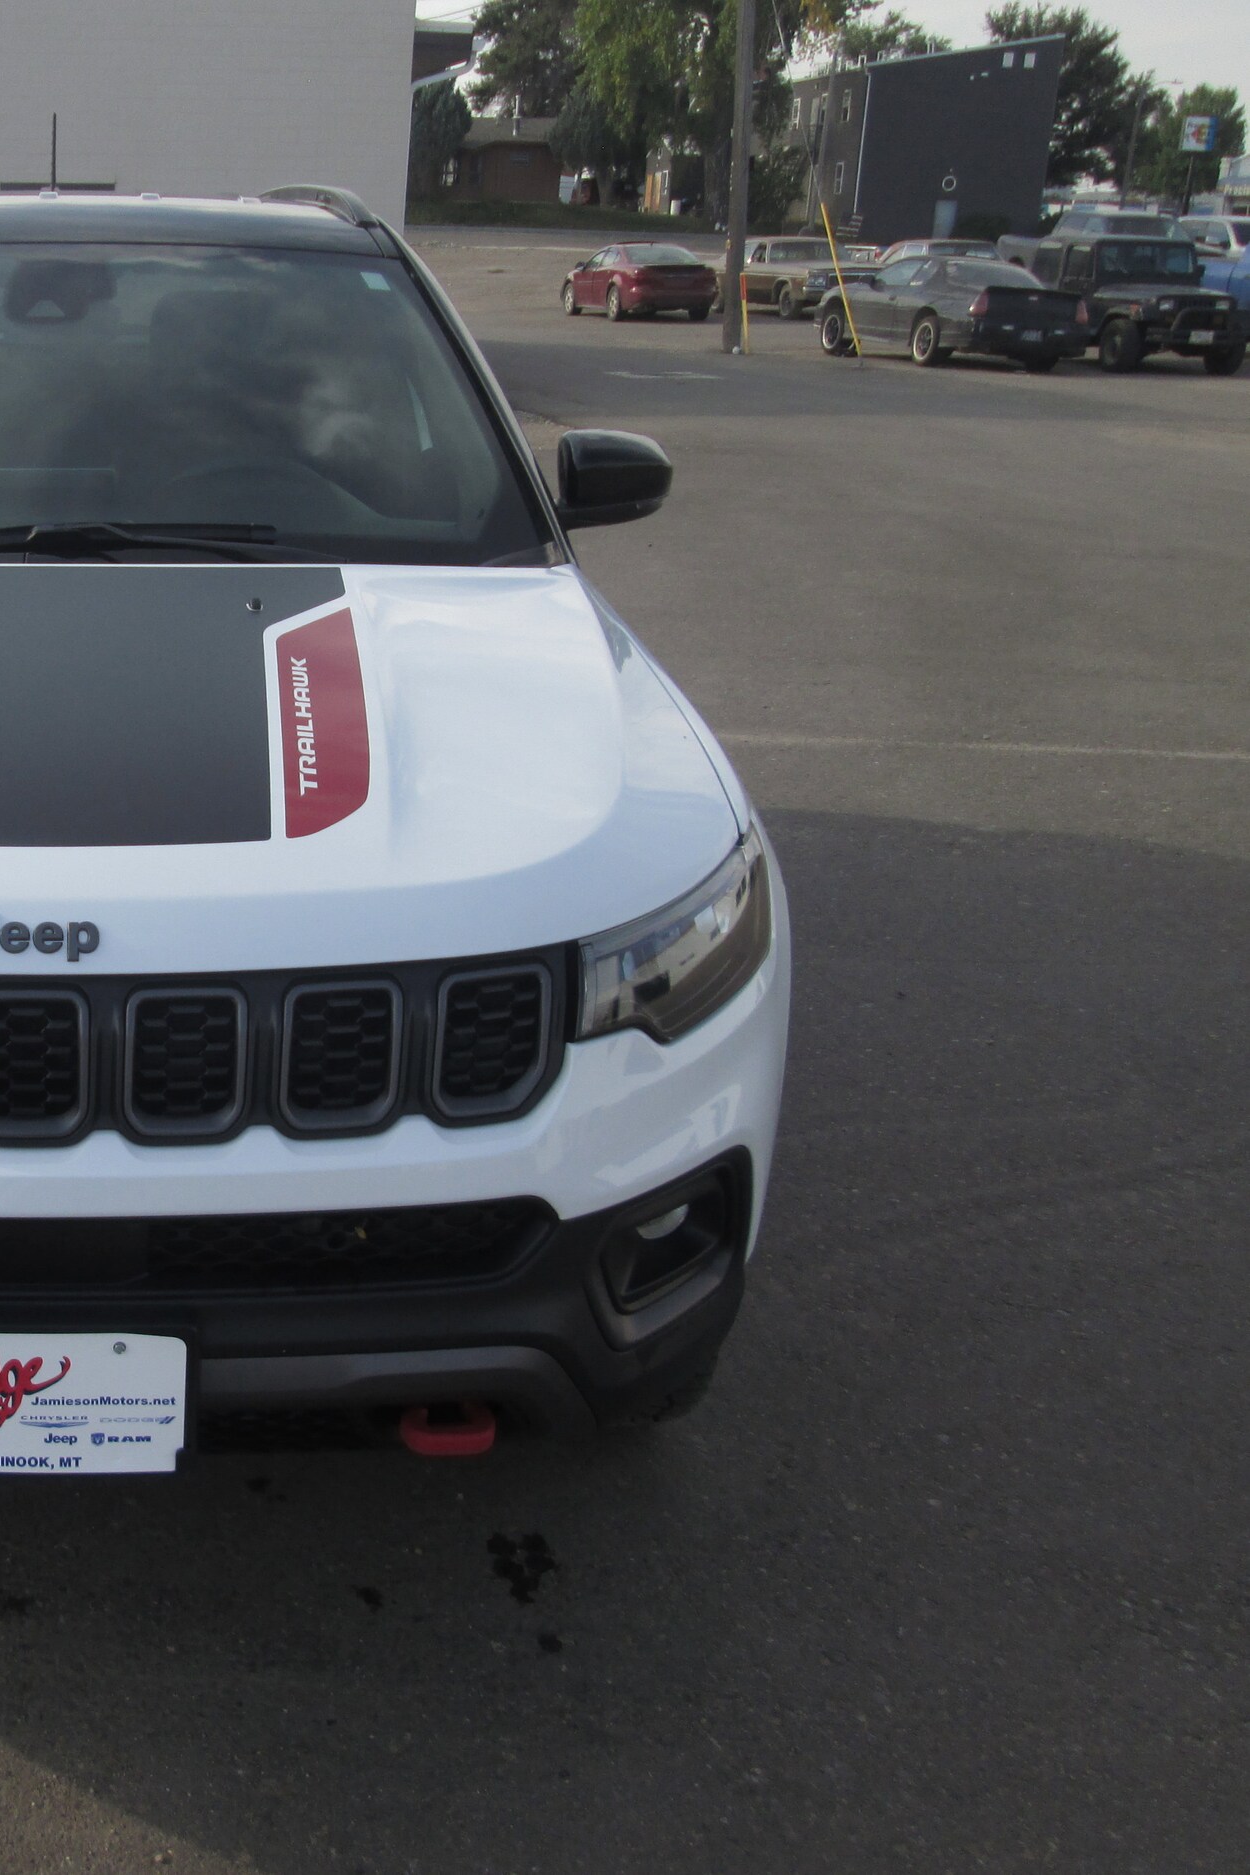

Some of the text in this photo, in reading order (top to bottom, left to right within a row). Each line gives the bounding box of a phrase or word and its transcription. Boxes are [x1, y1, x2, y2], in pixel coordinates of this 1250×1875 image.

[291, 656, 318, 796] TRAILHAWK
[31, 1396, 177, 1406] JamiesonMotors.net
[44, 1433, 78, 1446] Jeep
[107, 1435, 152, 1443] RAM
[59, 1456, 82, 1468] MT
